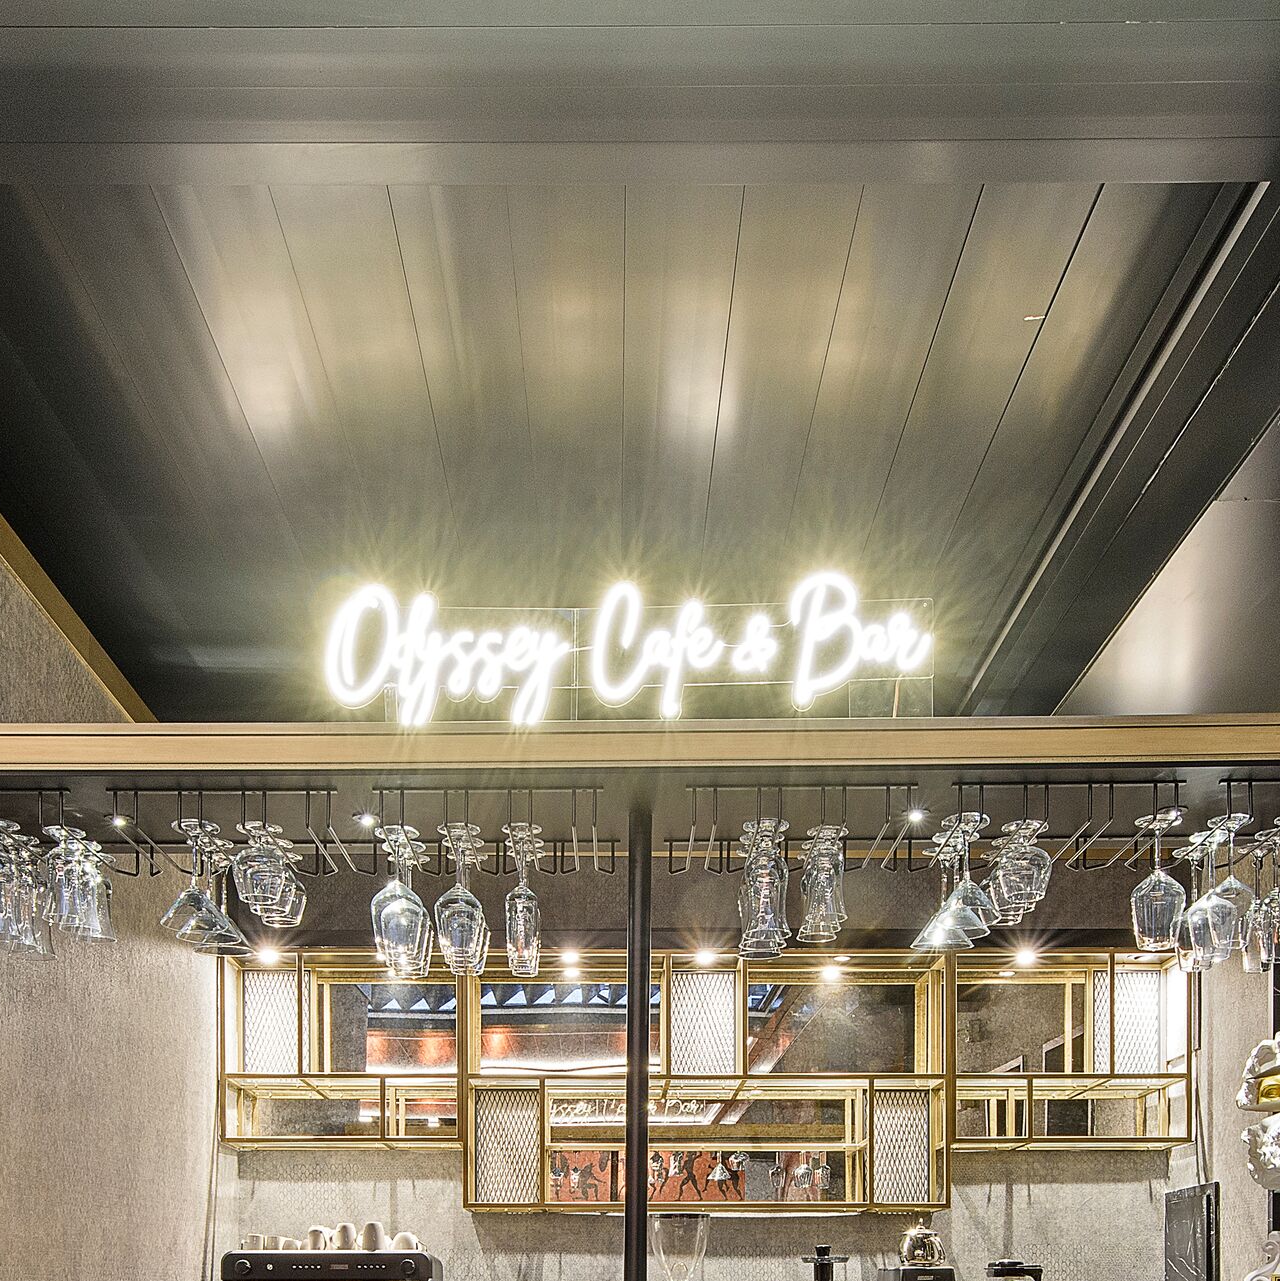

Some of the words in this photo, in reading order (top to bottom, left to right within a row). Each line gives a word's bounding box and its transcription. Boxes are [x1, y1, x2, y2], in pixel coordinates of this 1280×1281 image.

[326, 585, 569, 726] Odyssey
[592, 580, 723, 719] Cafe
[732, 614, 778, 672] &
[790, 572, 933, 711] Bar
